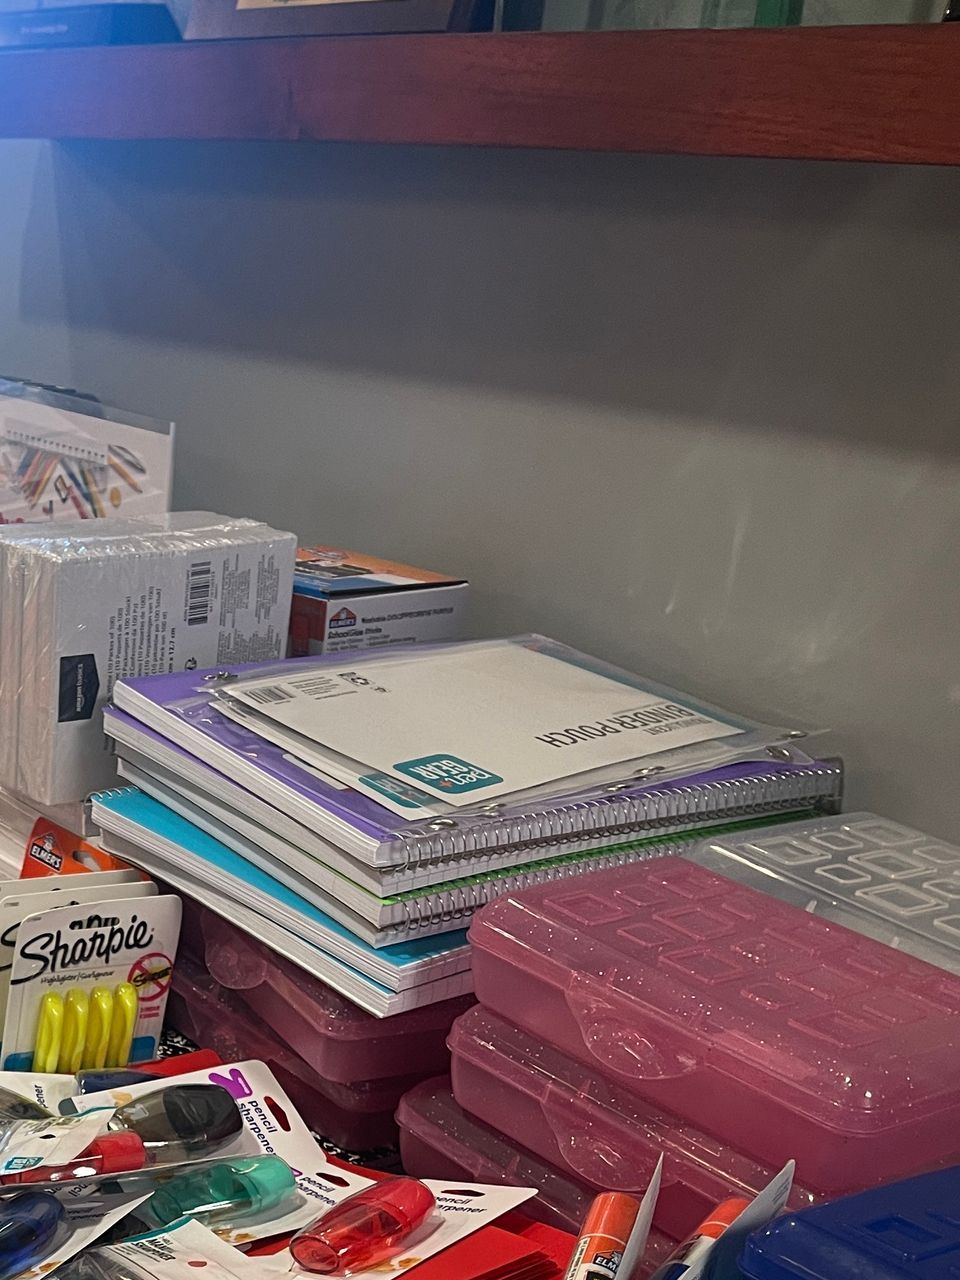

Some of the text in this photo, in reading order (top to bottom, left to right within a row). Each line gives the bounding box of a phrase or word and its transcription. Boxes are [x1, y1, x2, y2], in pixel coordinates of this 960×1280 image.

[535, 704, 695, 748] BINDER POUCH
[31, 845, 61, 868] ELMER'S
[11, 914, 155, 985] Sharpie
[248, 1100, 278, 1133] pencil
[300, 1176, 336, 1193] pencil
